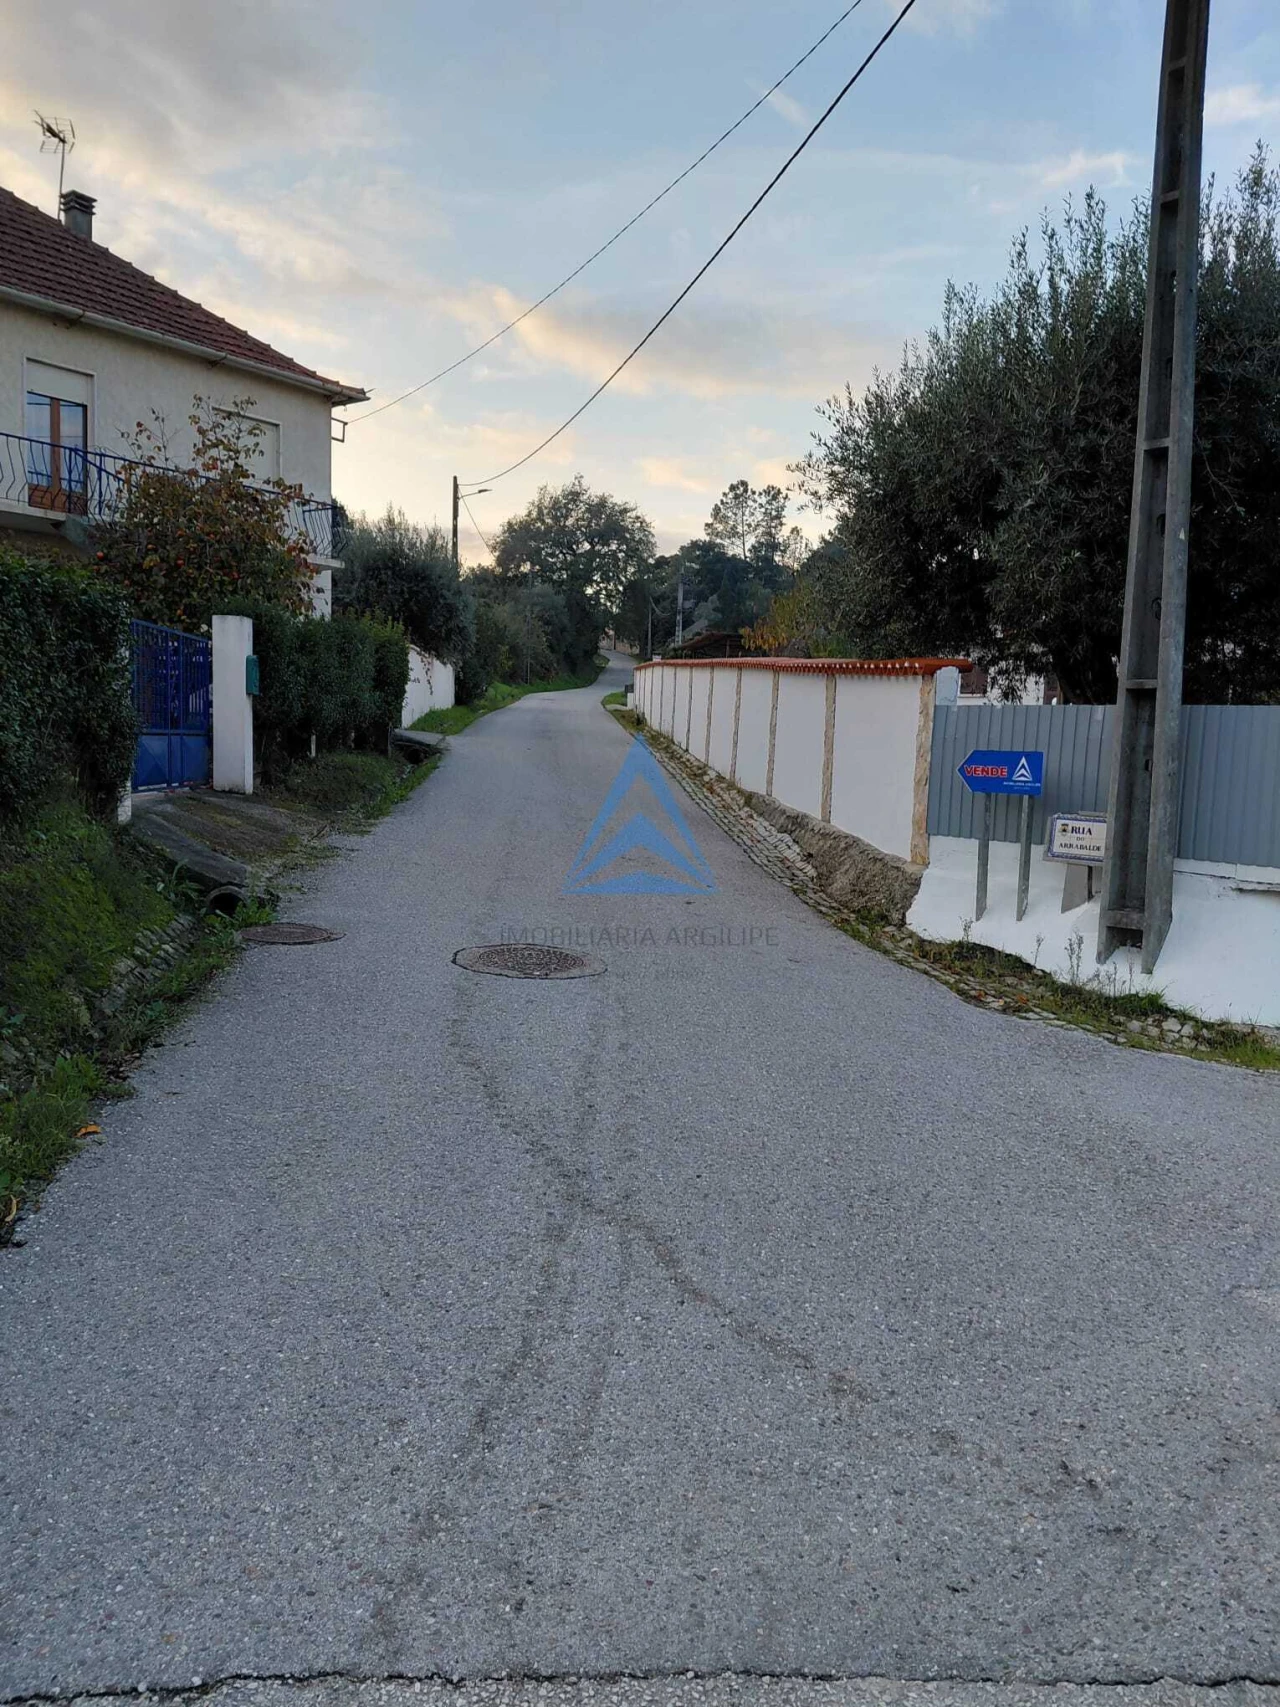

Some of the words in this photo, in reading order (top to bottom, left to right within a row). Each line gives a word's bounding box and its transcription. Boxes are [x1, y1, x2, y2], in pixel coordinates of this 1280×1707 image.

[964, 765, 1008, 778] VENDE
[1071, 826, 1092, 836] RUA
[1059, 842, 1102, 852] ARRABALDE
